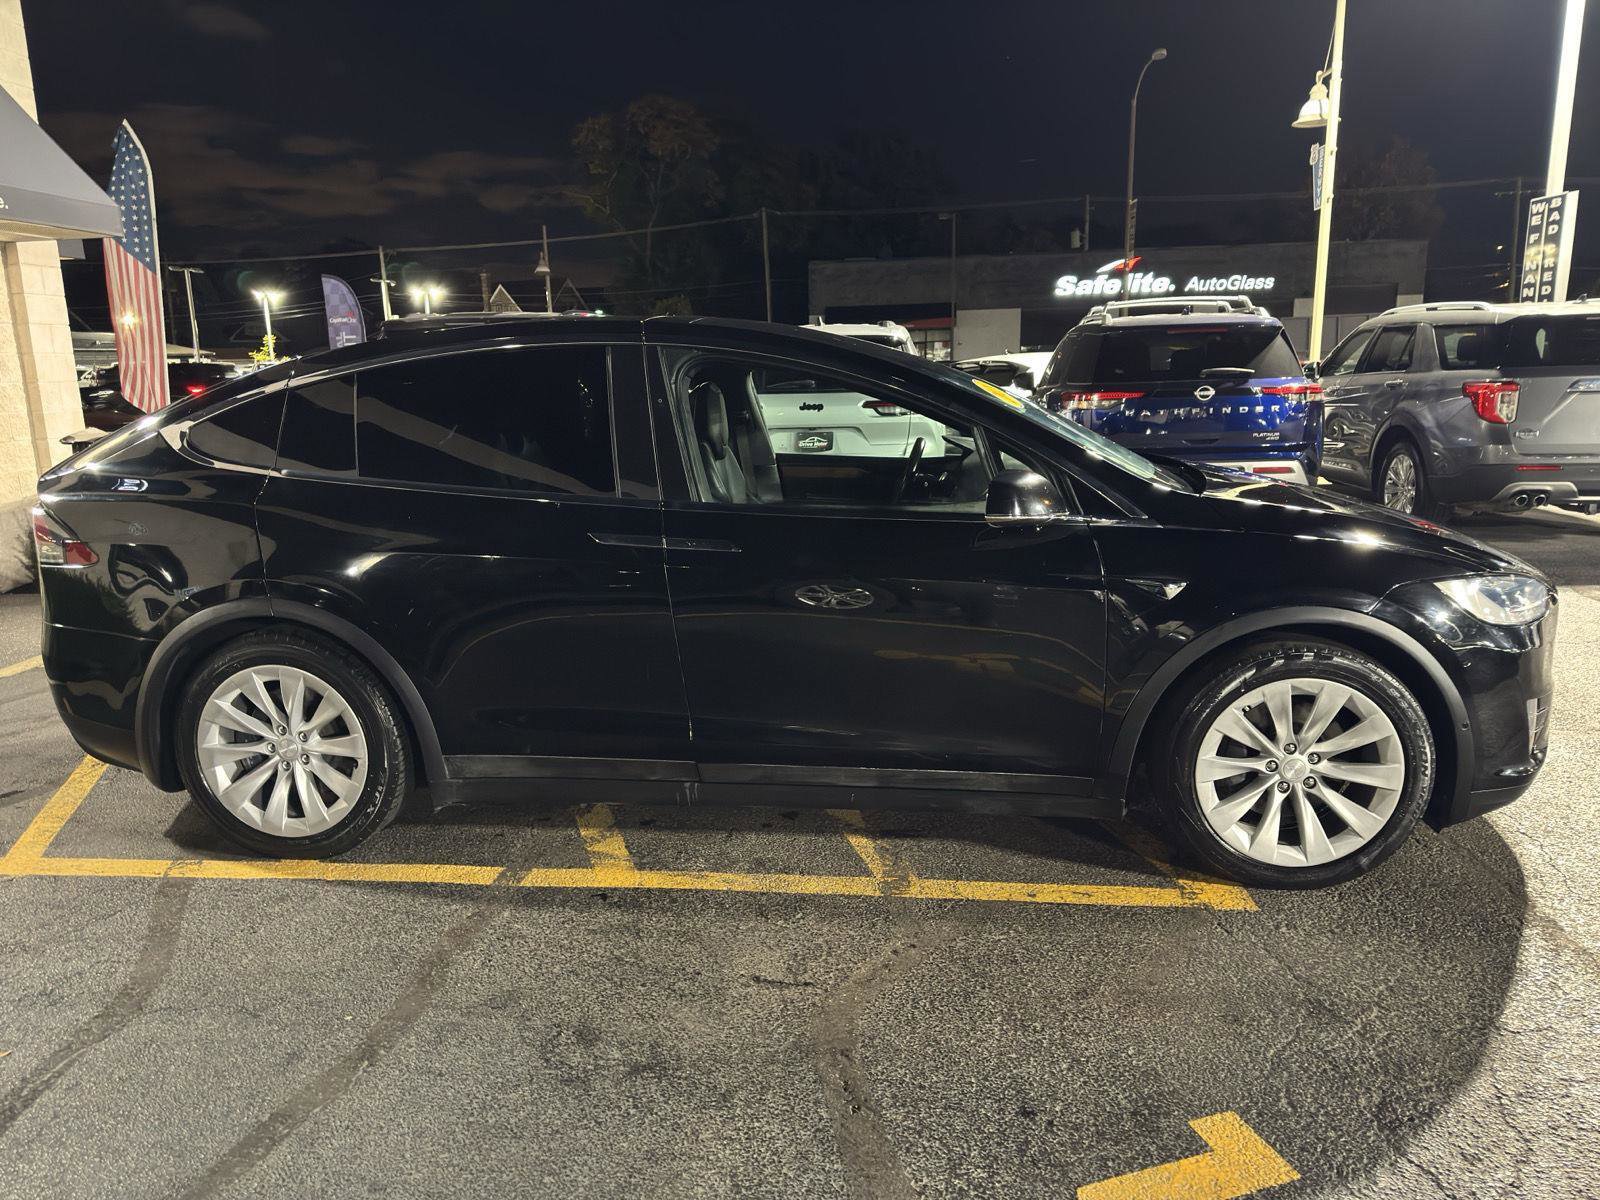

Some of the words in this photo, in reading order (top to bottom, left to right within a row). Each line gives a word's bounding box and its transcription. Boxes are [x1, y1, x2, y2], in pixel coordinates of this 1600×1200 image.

[1531, 201, 1546, 226] WE
[1549, 197, 1562, 235] BAD
[1523, 233, 1539, 303] FINAN
[1541, 243, 1557, 303] CRED
[1184, 274, 1276, 293] AutoGlass
[799, 402, 824, 412] Jeep
[1125, 404, 1281, 417] PATHFINDER
